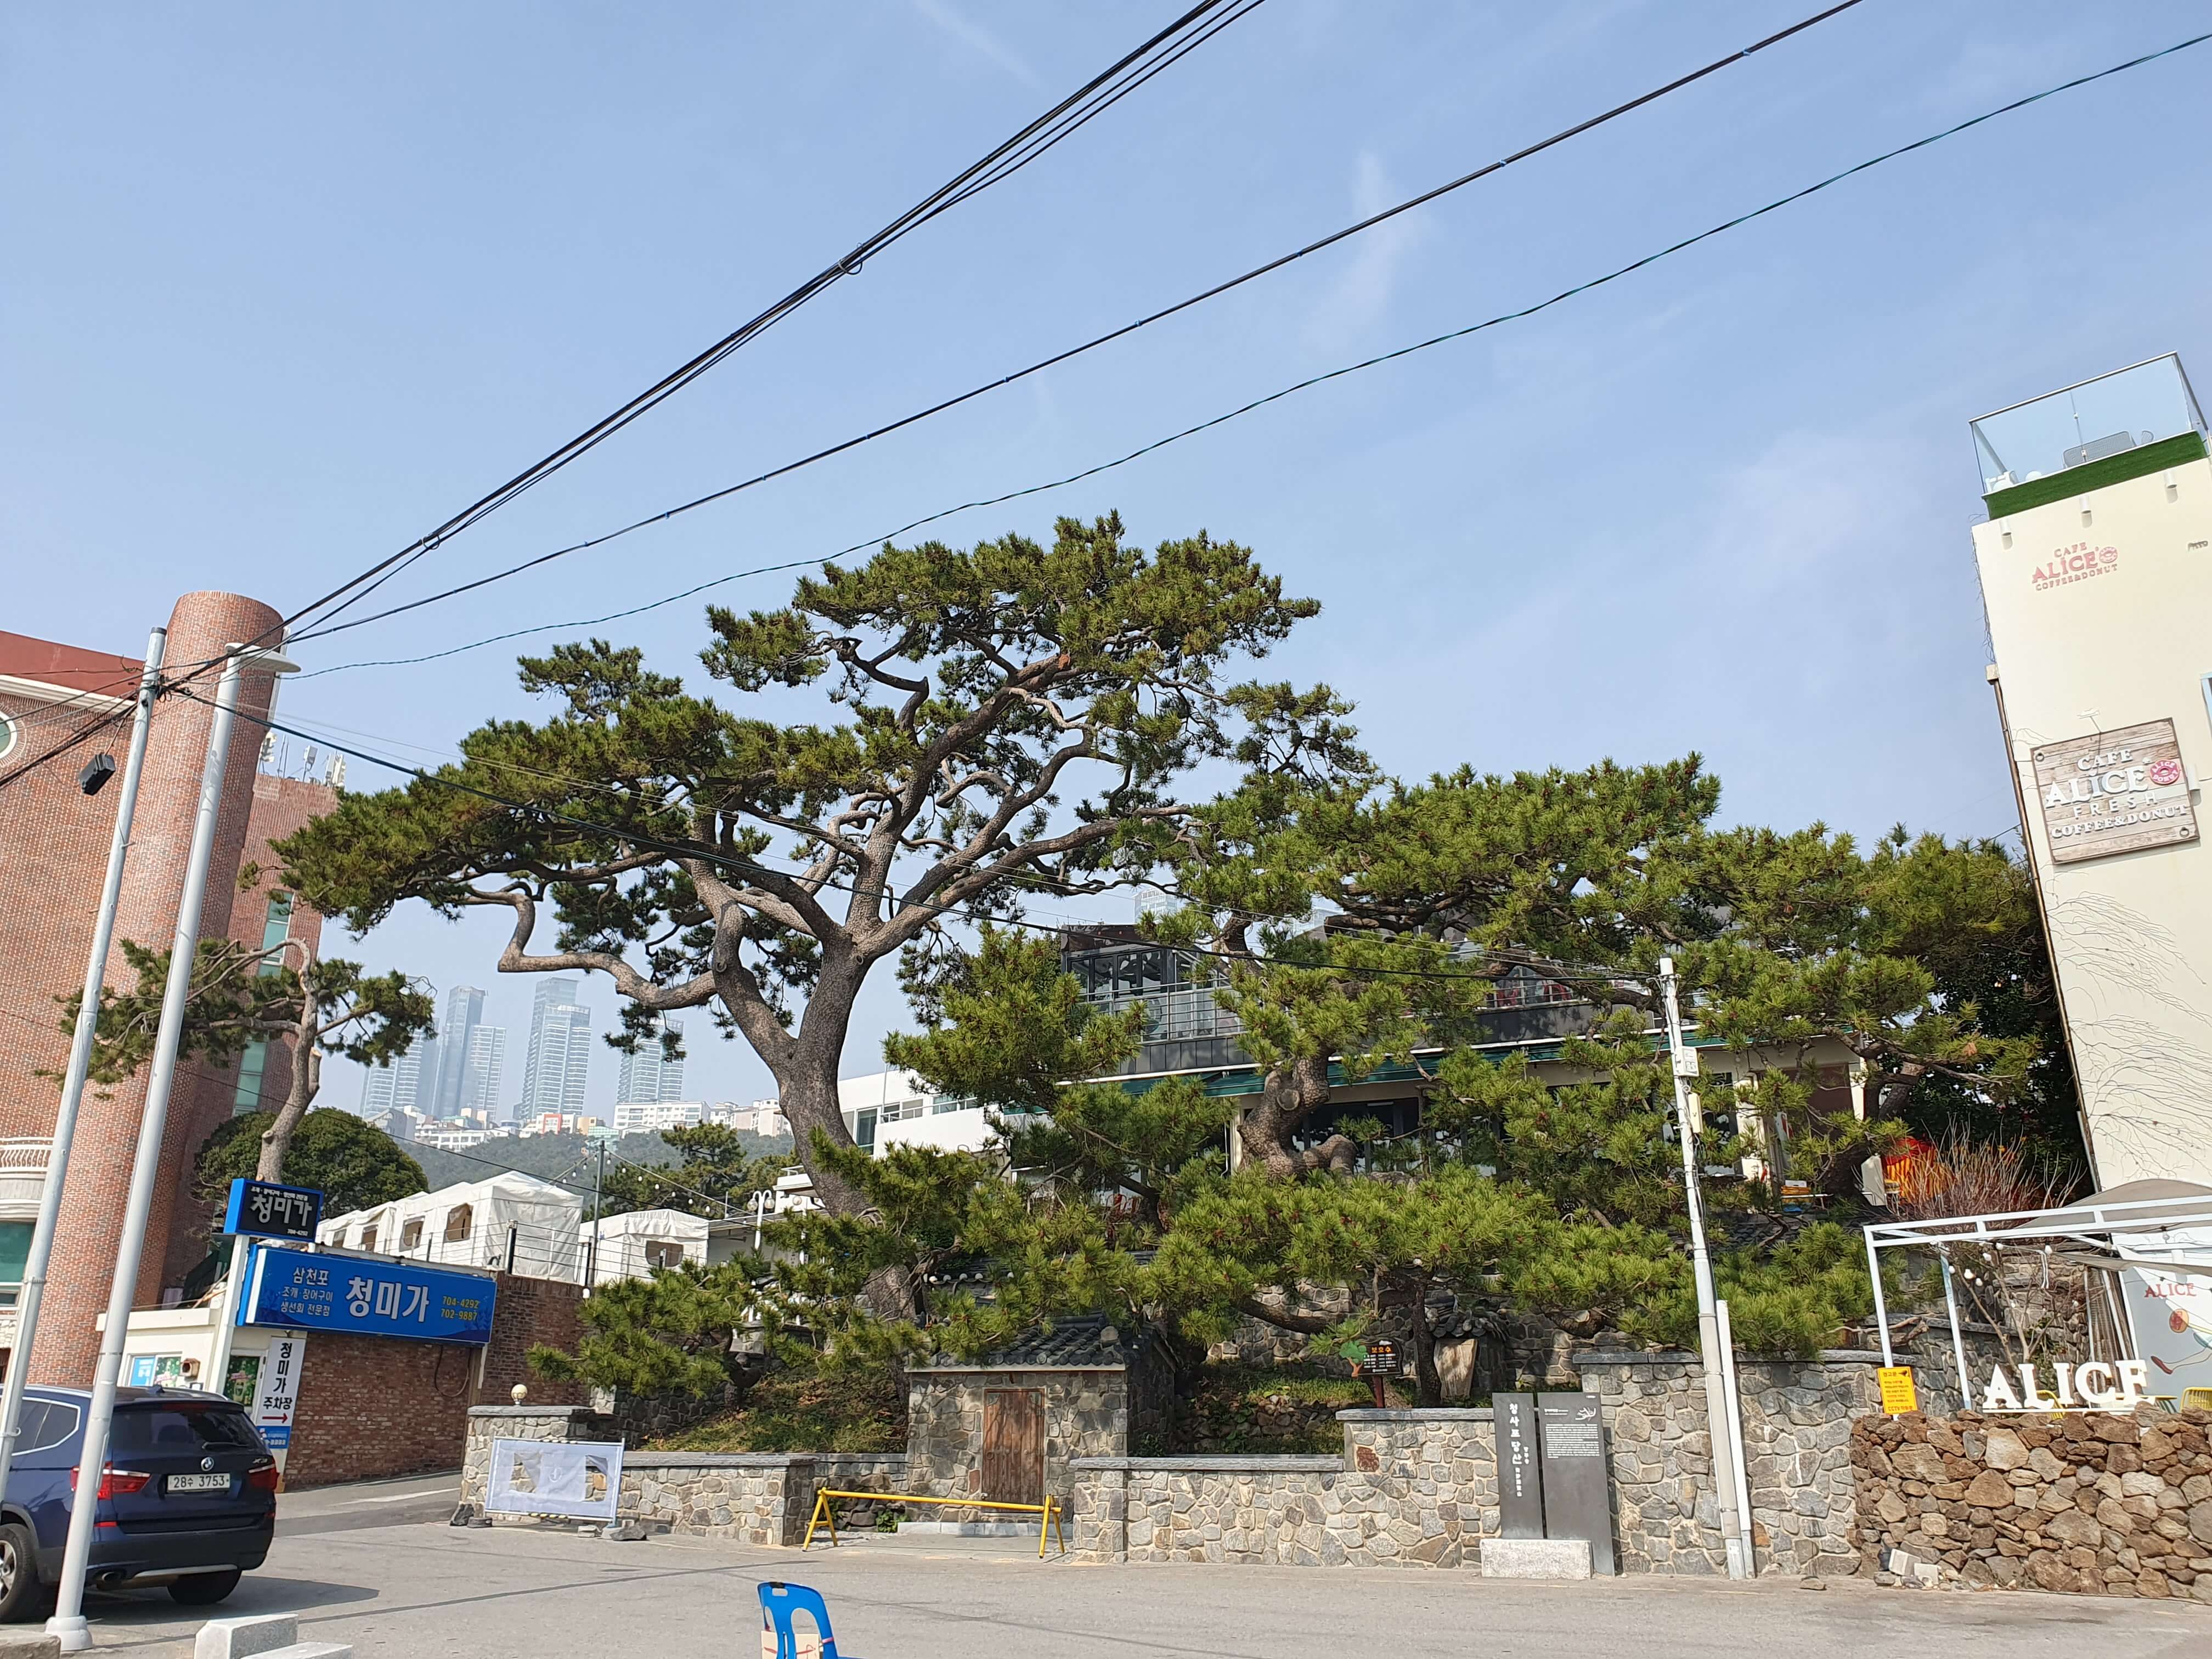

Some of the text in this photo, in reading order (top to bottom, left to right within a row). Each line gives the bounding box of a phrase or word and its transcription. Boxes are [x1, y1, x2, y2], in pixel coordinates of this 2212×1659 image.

[2054, 542, 2087, 558] CAFE
[2078, 749, 2133, 771] CAFE
[2073, 792, 2158, 819] FRESH
[2051, 805, 2187, 838] COFFEE&DONUT
[250, 1194, 312, 1227] 청미가
[293, 1267, 329, 1286] 삼천포
[346, 1276, 430, 1322] 청미가
[2144, 1283, 2197, 1298] ALICE
[280, 1301, 330, 1316] 생선회 전문점
[443, 1295, 479, 1310] 704-4292
[441, 1308, 477, 1321] 702-9887
[273, 1342, 292, 1393] 청미가
[1983, 1359, 2155, 1409] ALICE
[263, 1397, 292, 1410] 주차장
[174, 1475, 224, 1488] 28수 3753
